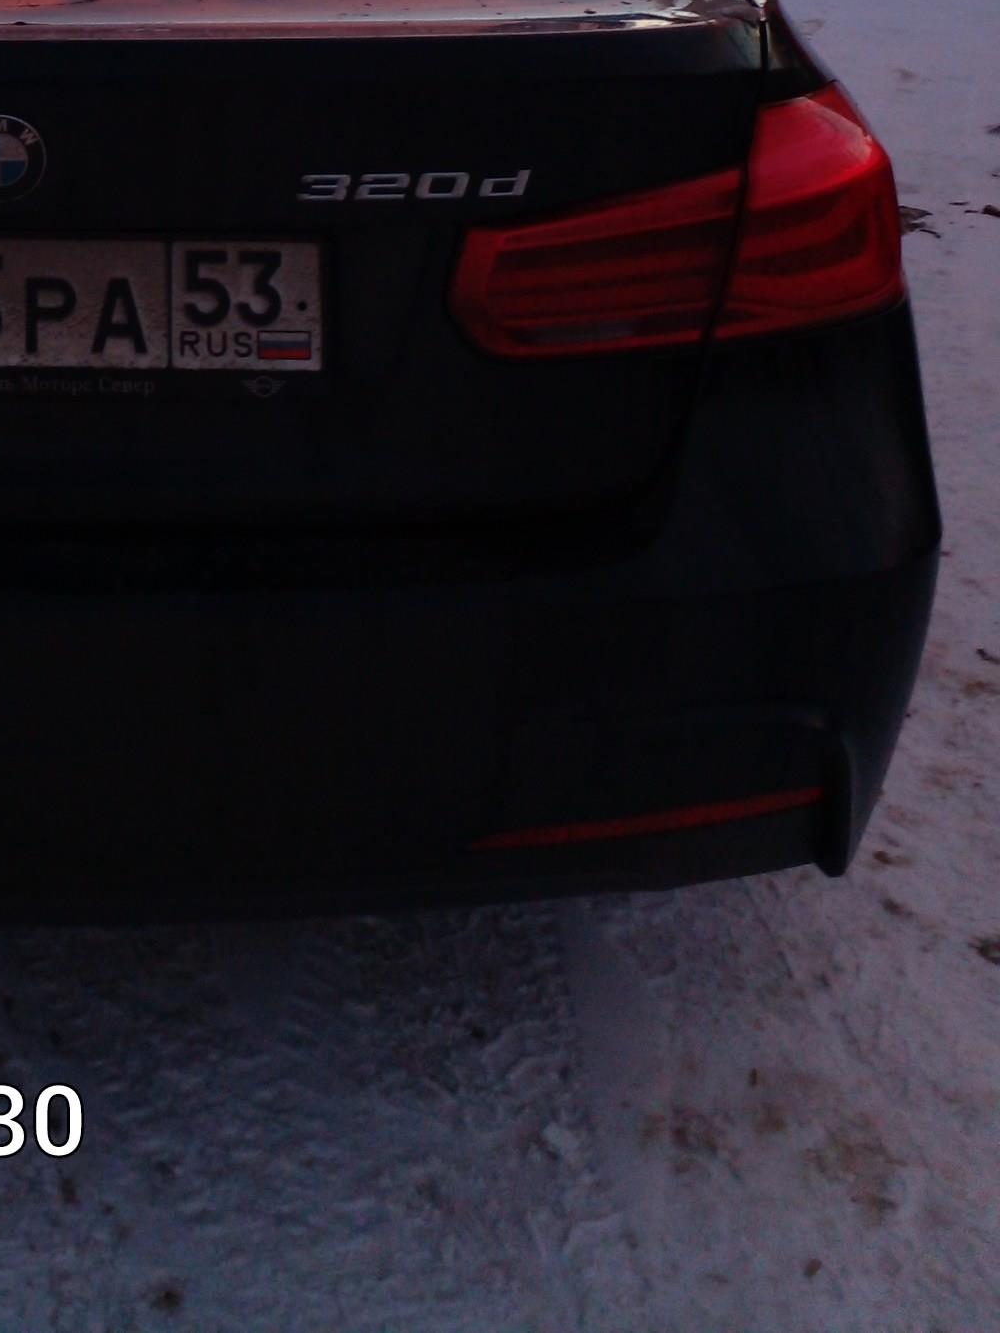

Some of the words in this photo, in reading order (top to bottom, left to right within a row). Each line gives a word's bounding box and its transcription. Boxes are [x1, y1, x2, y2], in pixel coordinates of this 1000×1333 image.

[298, 169, 533, 202] 320d
[182, 249, 284, 328] 53
[179, 331, 256, 359] RUS
